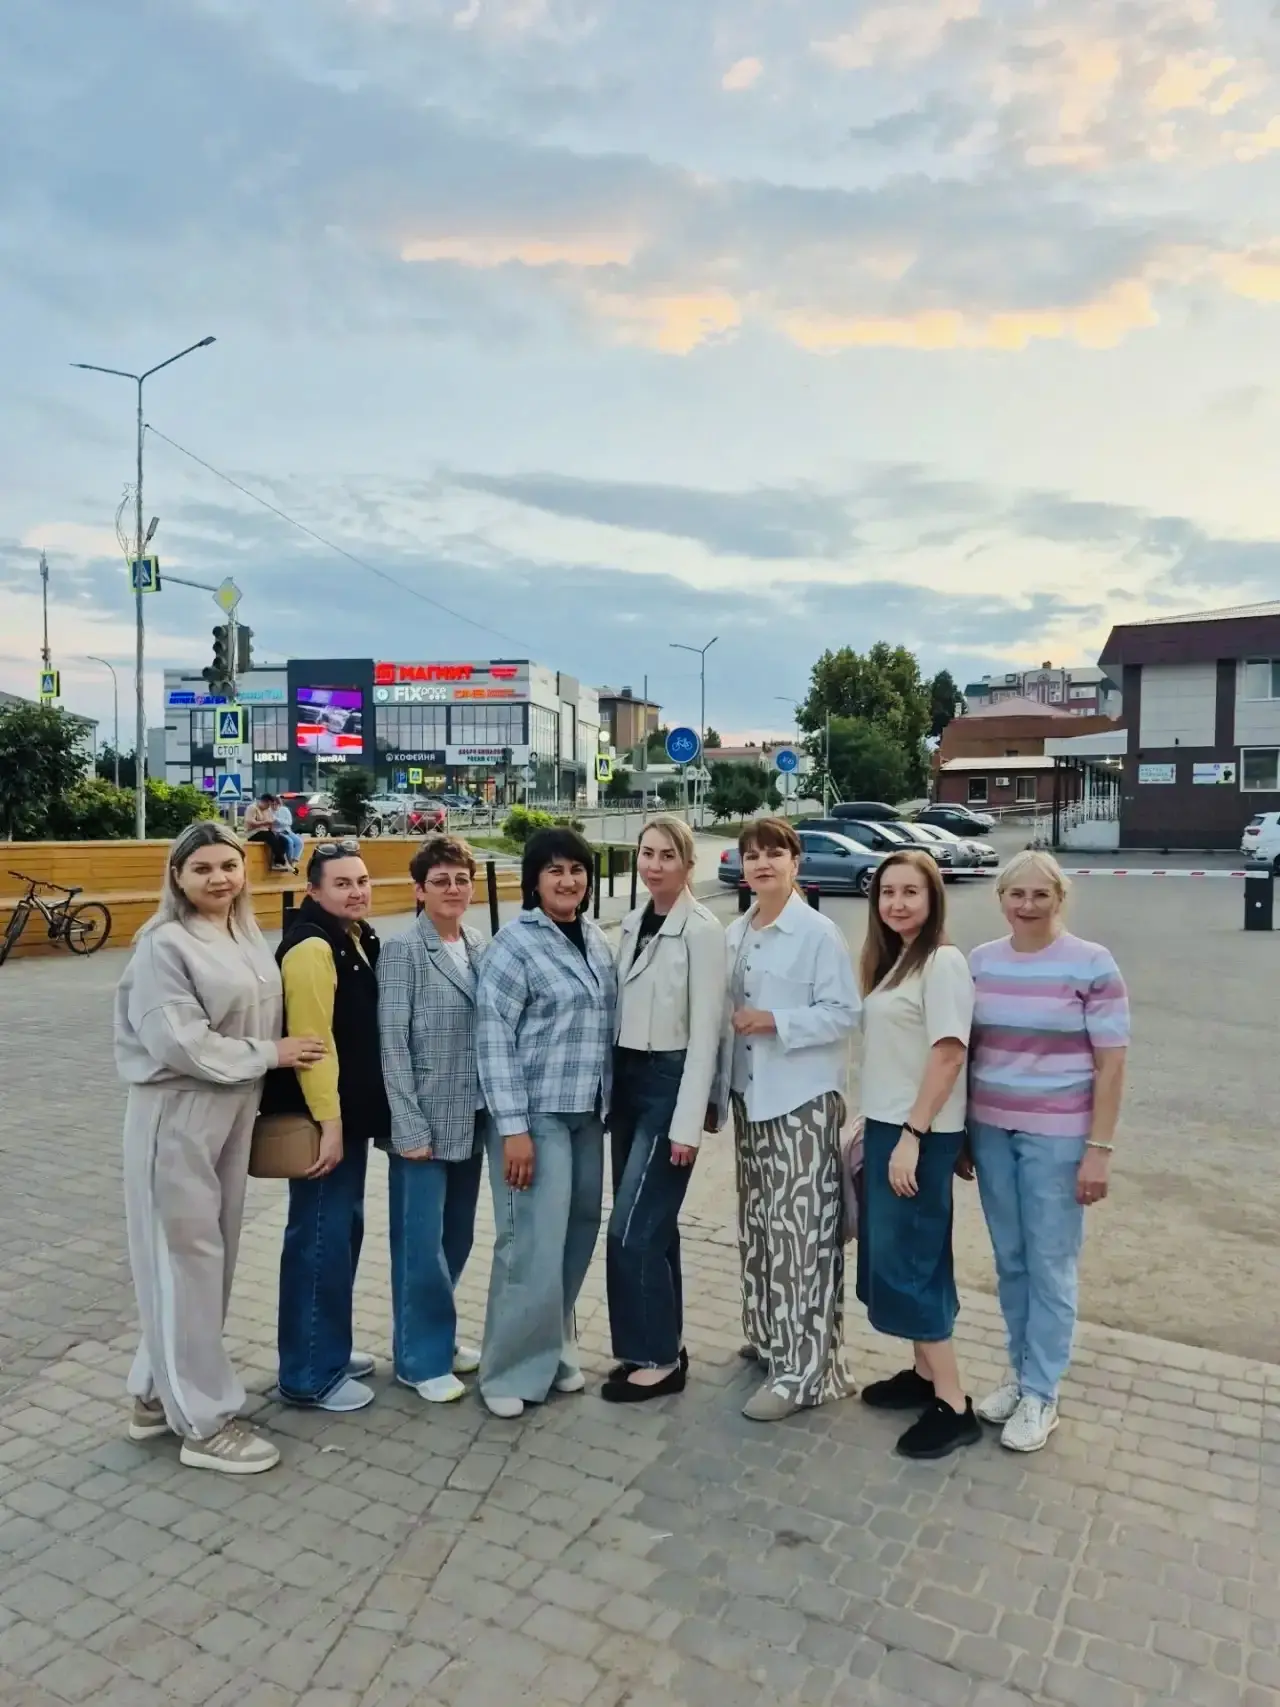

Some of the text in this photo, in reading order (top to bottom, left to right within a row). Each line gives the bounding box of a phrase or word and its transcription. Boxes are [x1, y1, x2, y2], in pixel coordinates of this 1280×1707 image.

[399, 664, 473, 681] МАГНИТ
[217, 745, 239, 756] СТОП
[254, 752, 288, 762] ЦВЕТЫ
[394, 753, 436, 761] КОФЕЙНЯ
